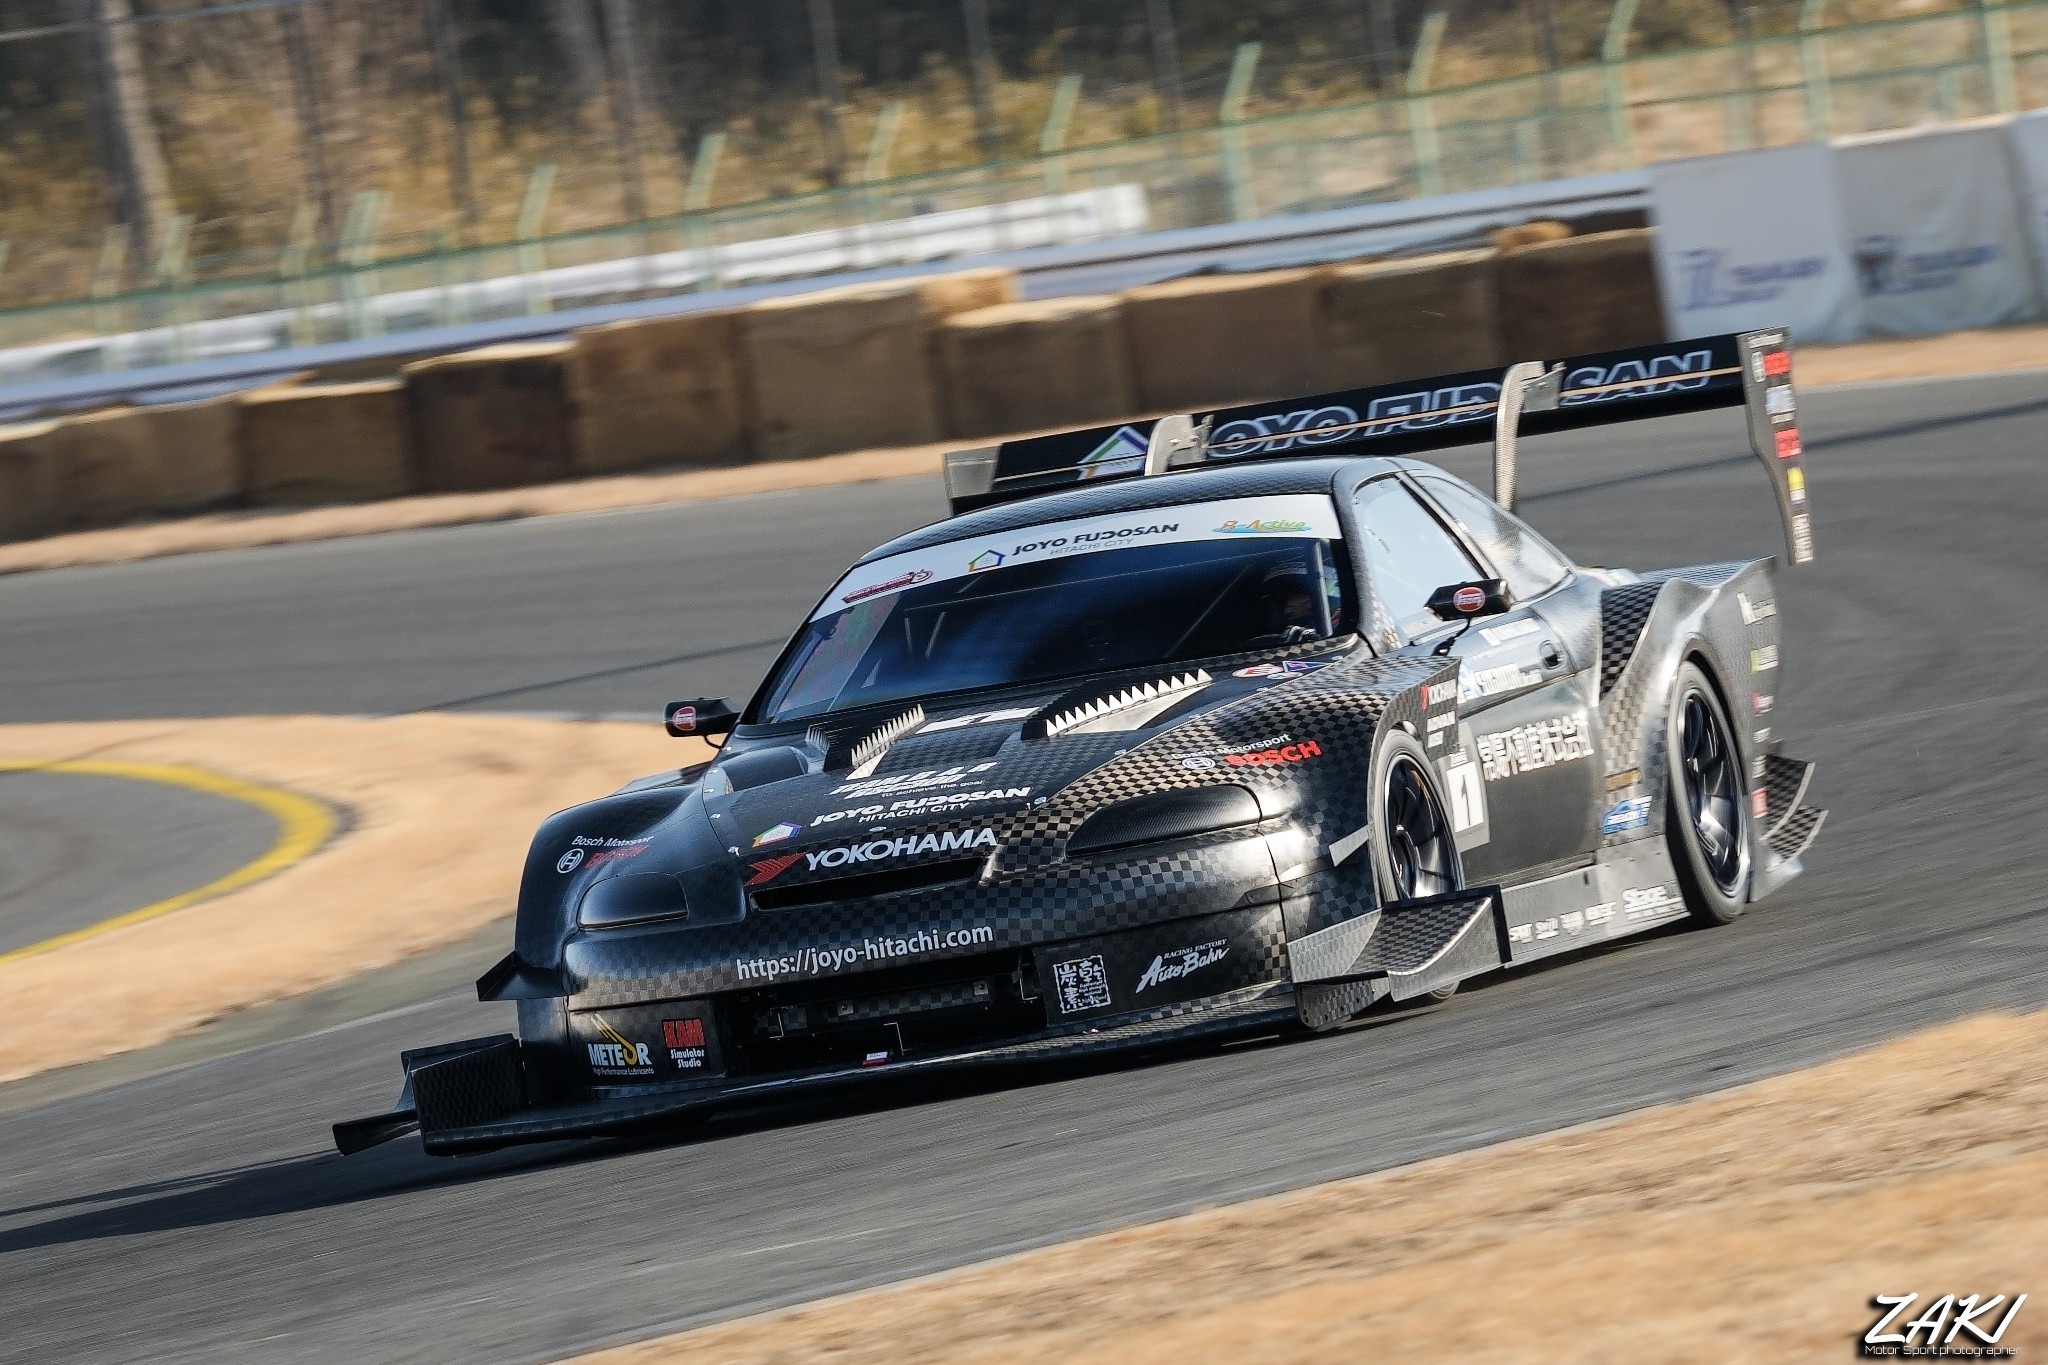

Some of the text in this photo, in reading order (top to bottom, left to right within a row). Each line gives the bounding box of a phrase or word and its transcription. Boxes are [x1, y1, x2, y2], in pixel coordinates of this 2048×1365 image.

[1206, 405, 1359, 458] OYO
[1364, 350, 1712, 437] FUDSAN
[1011, 523, 1180, 556] JOYO FUDOSAN
[1049, 538, 1135, 556] HITACHI CITY
[1171, 733, 1293, 760] Bosch Motorsport
[1225, 739, 1322, 766] BOSCH
[810, 804, 884, 828] JOYO
[889, 786, 1032, 812] FUDOSAN
[858, 801, 971, 823] HITACHI CITY
[571, 835, 604, 846] Bosch
[806, 827, 998, 871] YOKOHAMA
[736, 925, 995, 981] https://joyo-hitachi.com
[1163, 938, 1228, 960] RACING FACTORY
[1135, 947, 1231, 994] AutoBahn
[662, 1019, 706, 1048] KAM
[587, 1042, 653, 1067] METEOR
[670, 1047, 705, 1060] Simulator
[677, 1058, 702, 1069] Studio
[628, 1067, 655, 1076] Lubricants
